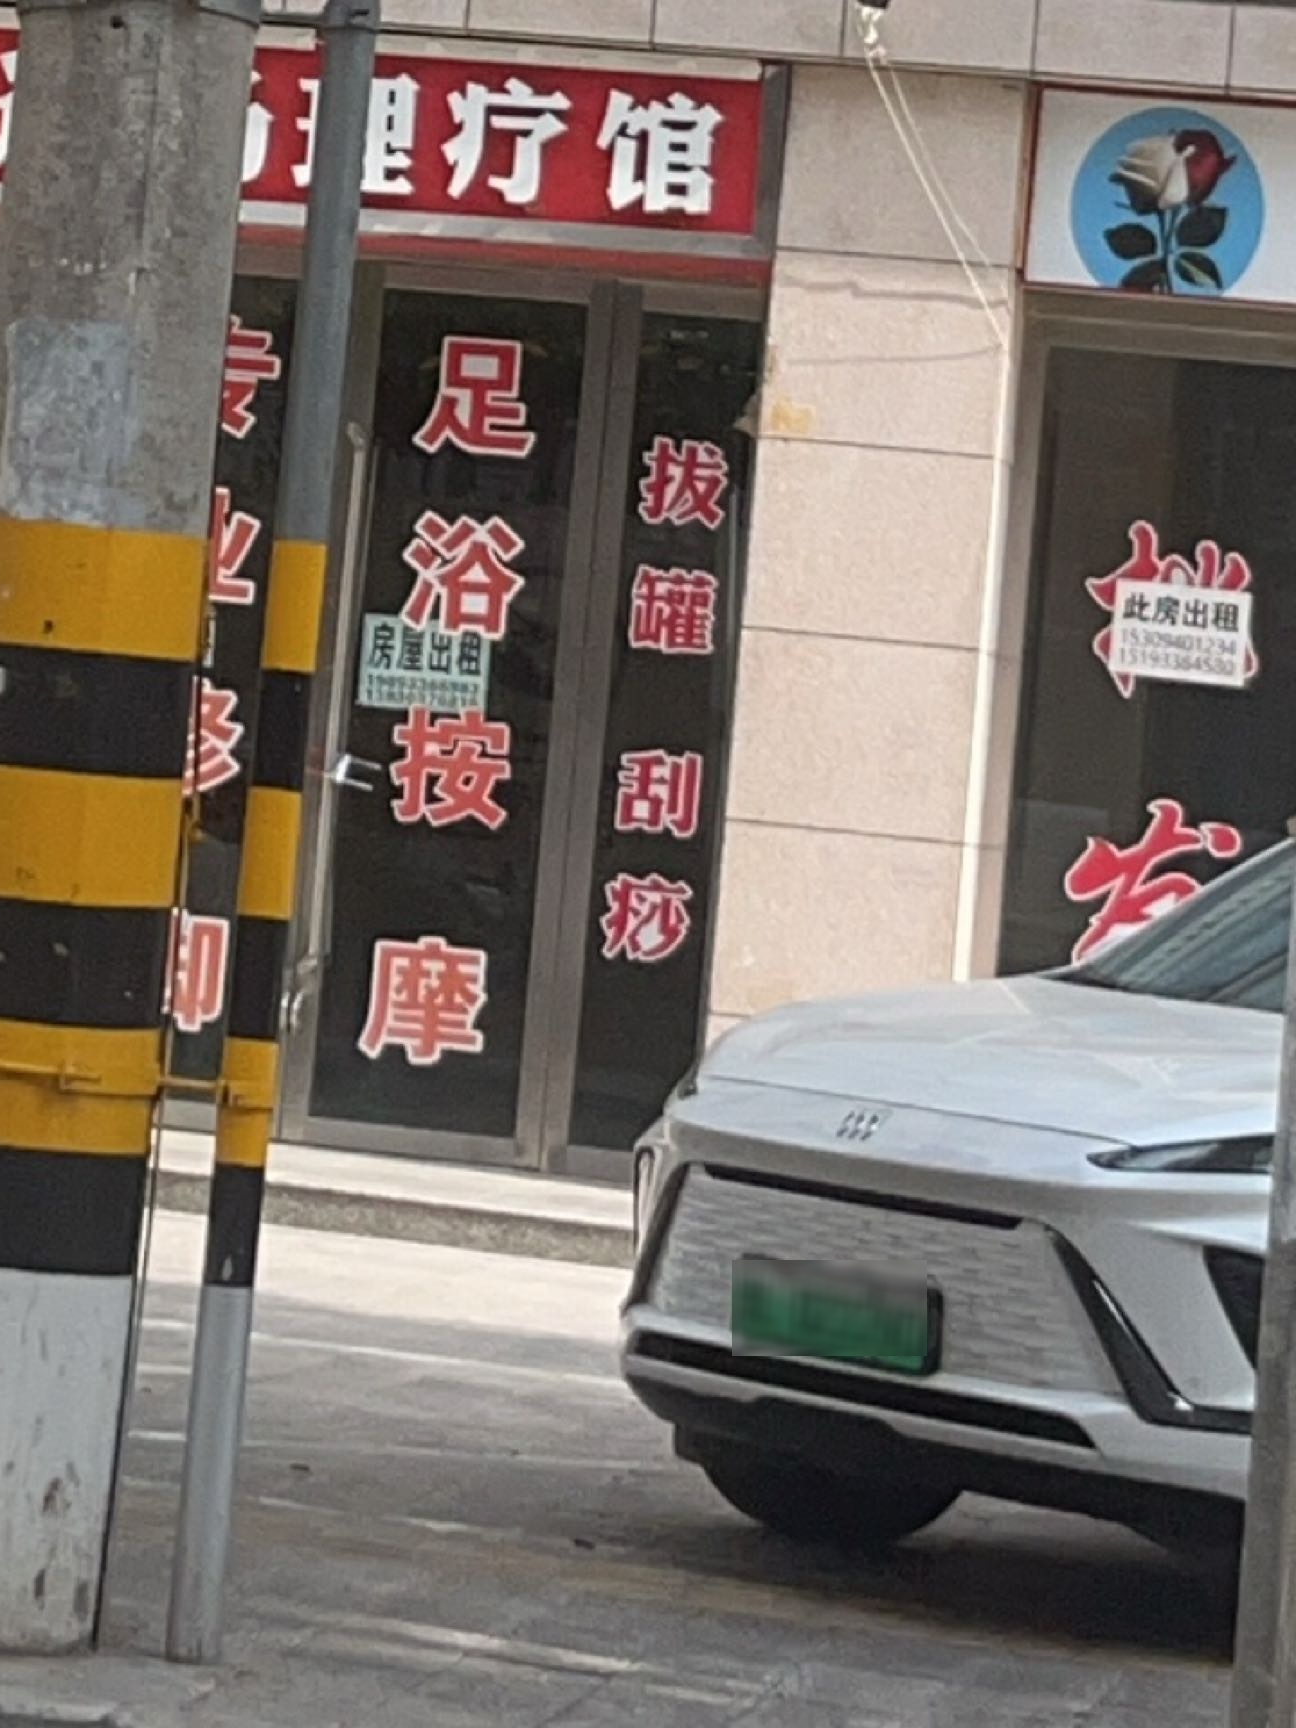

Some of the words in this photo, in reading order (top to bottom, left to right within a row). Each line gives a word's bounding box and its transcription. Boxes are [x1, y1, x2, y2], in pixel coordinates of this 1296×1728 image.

[358, 335, 536, 1065] 足浴按摩
[368, 623, 482, 676] 房屋出租
[600, 435, 730, 962] 拔罐刮痧
[1122, 591, 1240, 633] 此房出租
